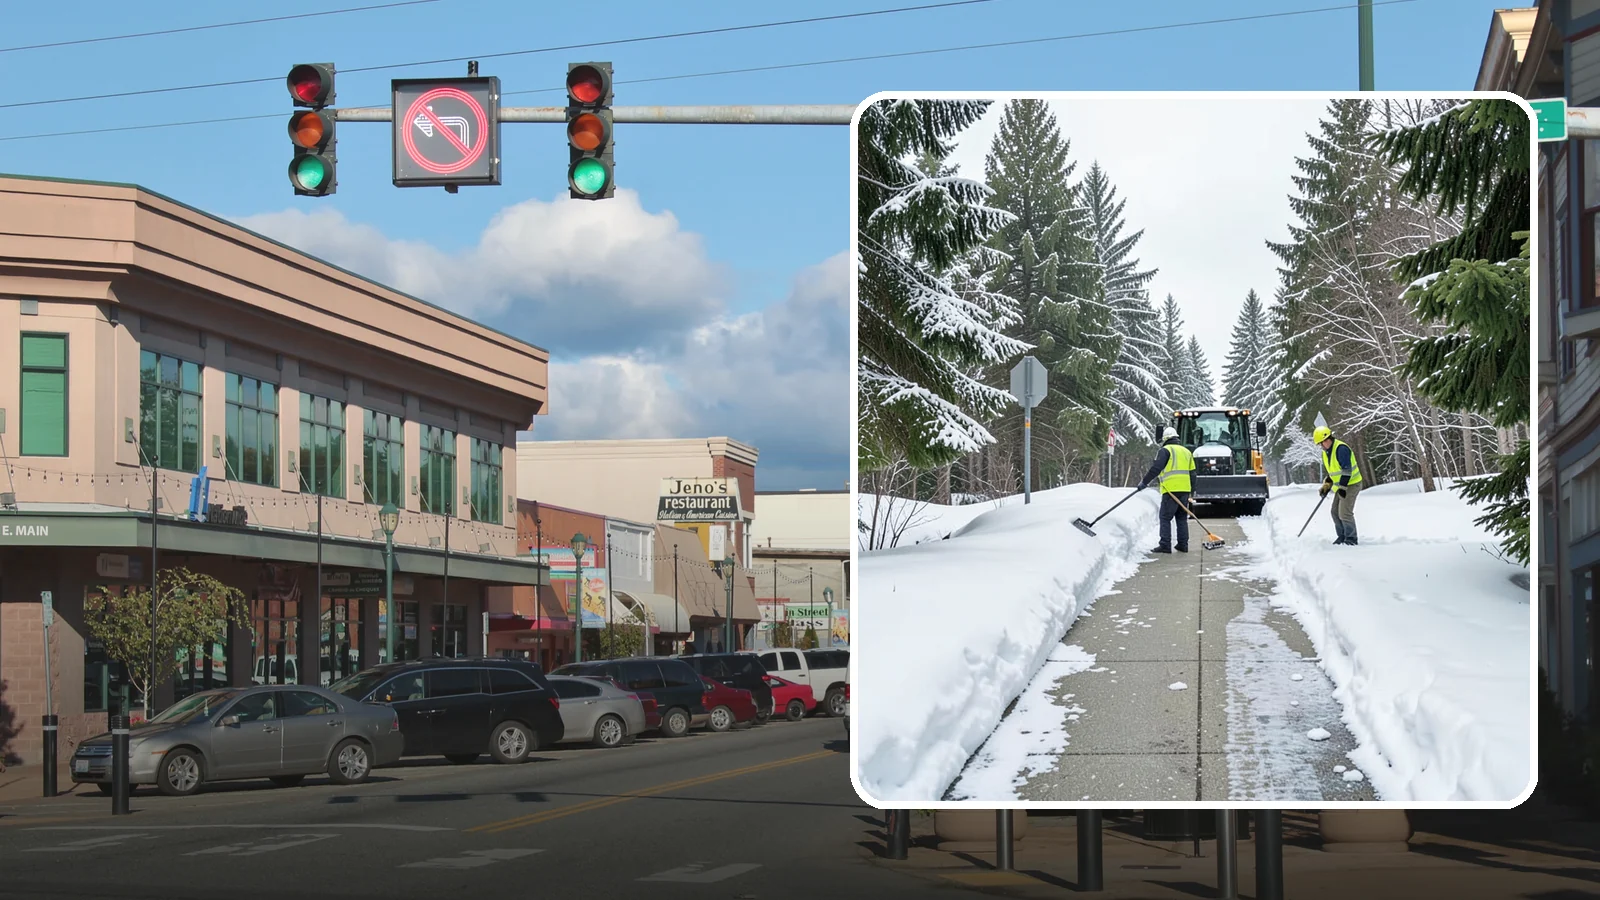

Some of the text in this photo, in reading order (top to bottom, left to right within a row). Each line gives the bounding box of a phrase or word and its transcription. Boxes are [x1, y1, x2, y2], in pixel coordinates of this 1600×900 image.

[670, 480, 727, 495] Jeno's
[665, 497, 731, 509] restaurant
[658, 510, 681, 519] Italian
[686, 510, 714, 519] American
[715, 509, 737, 519] Cuisine
[2, 525, 49, 536] E. MAIN
[797, 607, 828, 617] Street
